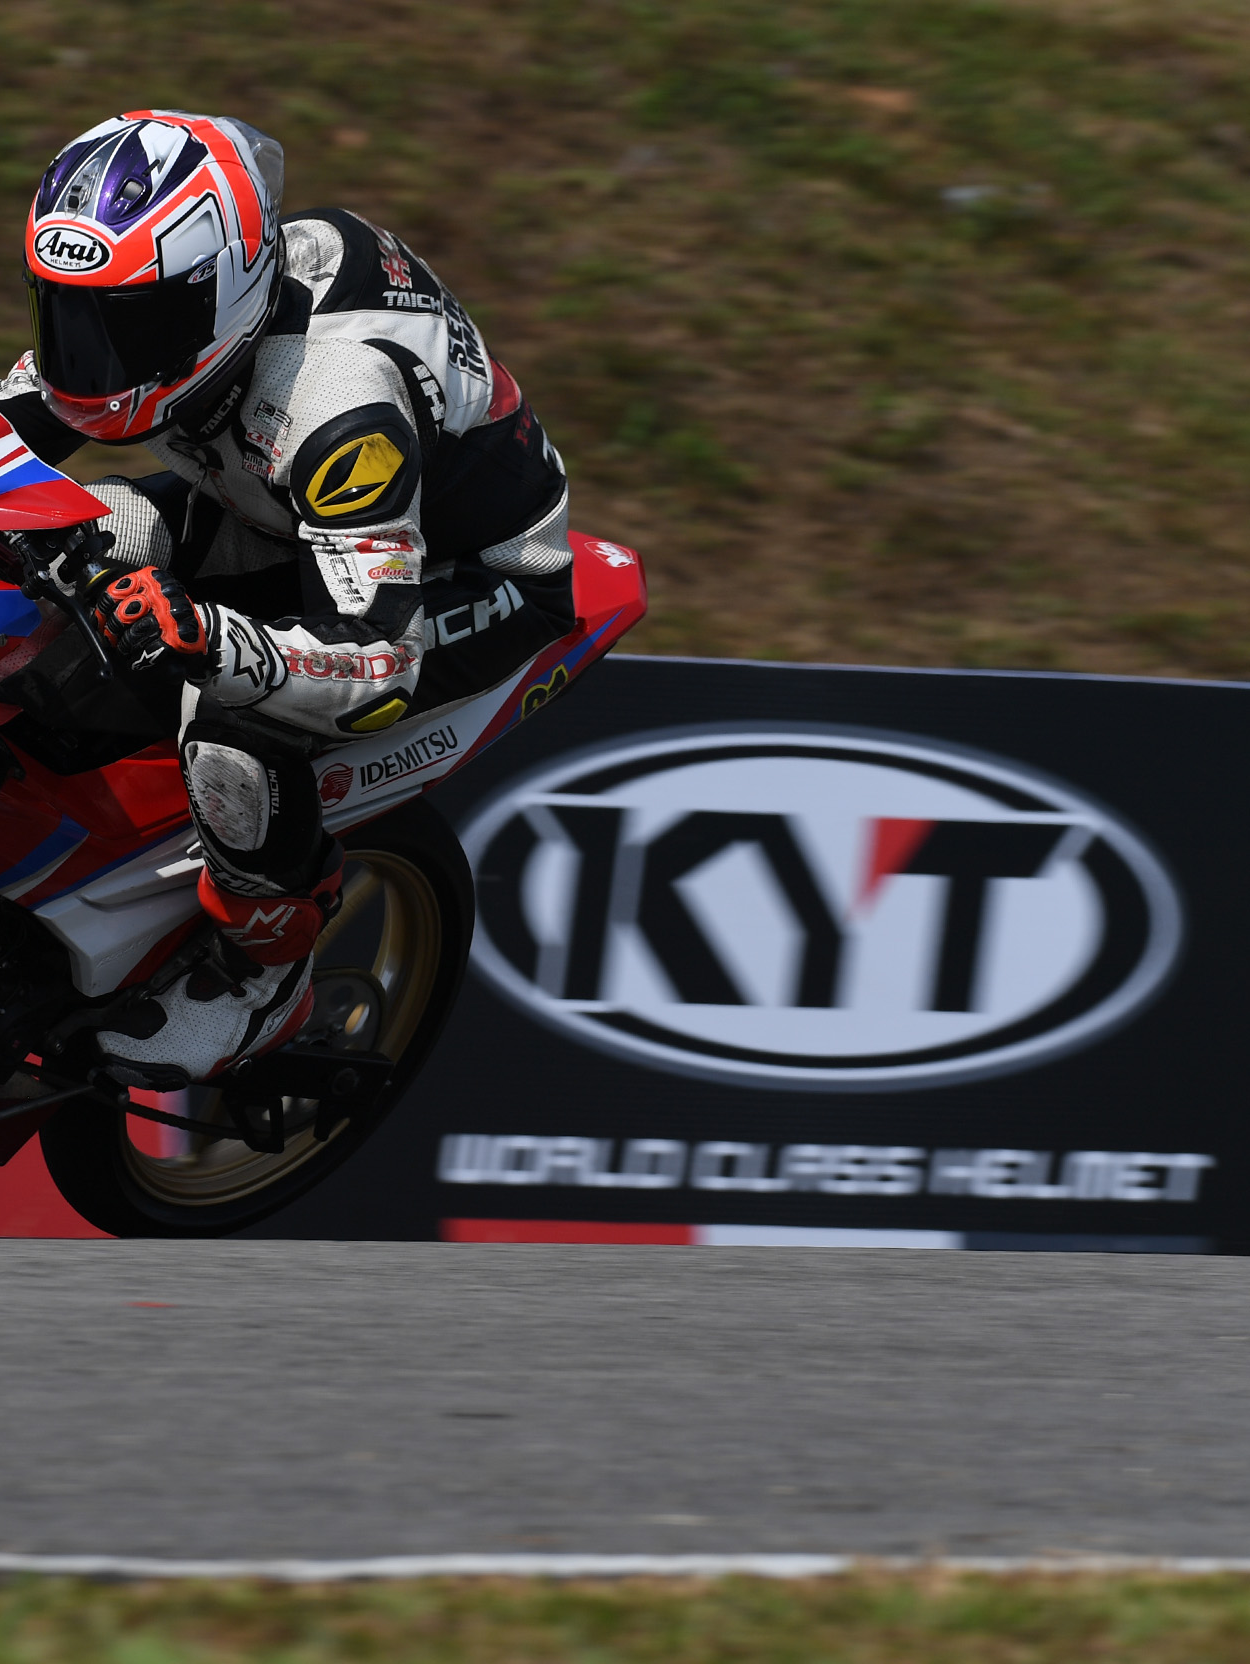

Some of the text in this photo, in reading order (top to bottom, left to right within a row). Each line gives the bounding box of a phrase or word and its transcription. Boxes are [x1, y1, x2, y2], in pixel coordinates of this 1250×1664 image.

[37, 231, 99, 262] Arai
[200, 384, 242, 434] TAICHI
[276, 644, 416, 680] HONDA
[359, 725, 459, 788] IDEMITSU
[267, 768, 280, 817] TAICHI
[543, 804, 1080, 1013] KYT
[437, 1133, 1216, 1202] WORLD CLASS HELMET
